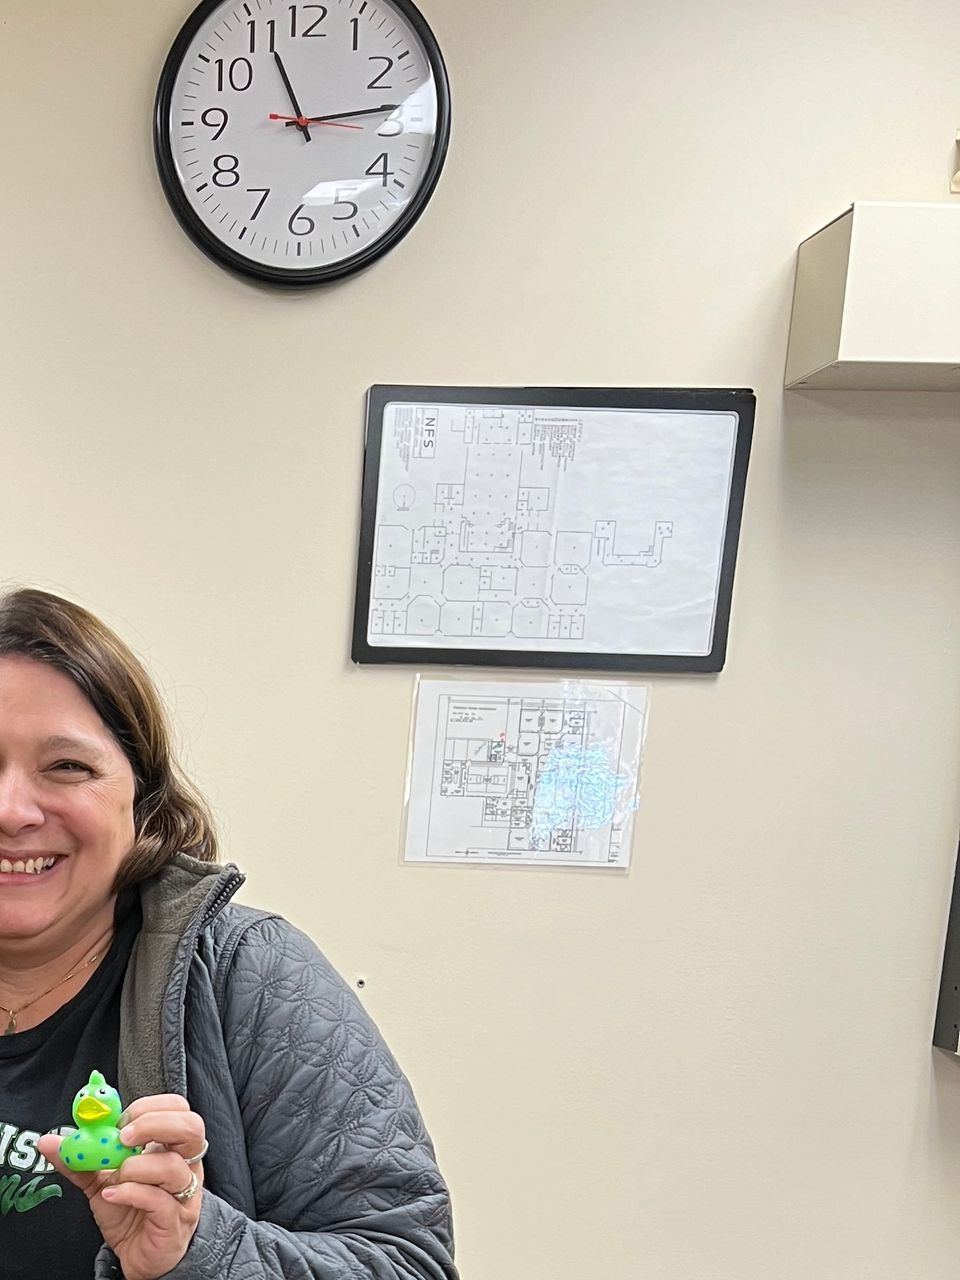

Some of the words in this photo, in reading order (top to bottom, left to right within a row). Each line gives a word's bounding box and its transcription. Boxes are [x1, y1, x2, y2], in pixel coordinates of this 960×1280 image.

[246, 19, 276, 53] 11
[288, 4, 328, 38] 12
[349, 17, 359, 51] 1
[213, 56, 254, 92] 10
[366, 55, 394, 90] 2
[200, 107, 229, 141] 9
[377, 105, 405, 137] 3
[211, 154, 241, 188] 8
[364, 152, 395, 188] 4
[246, 188, 271, 221] 7
[288, 203, 316, 236] 6
[331, 187, 359, 221] 5
[423, 416, 437, 449] NFS
